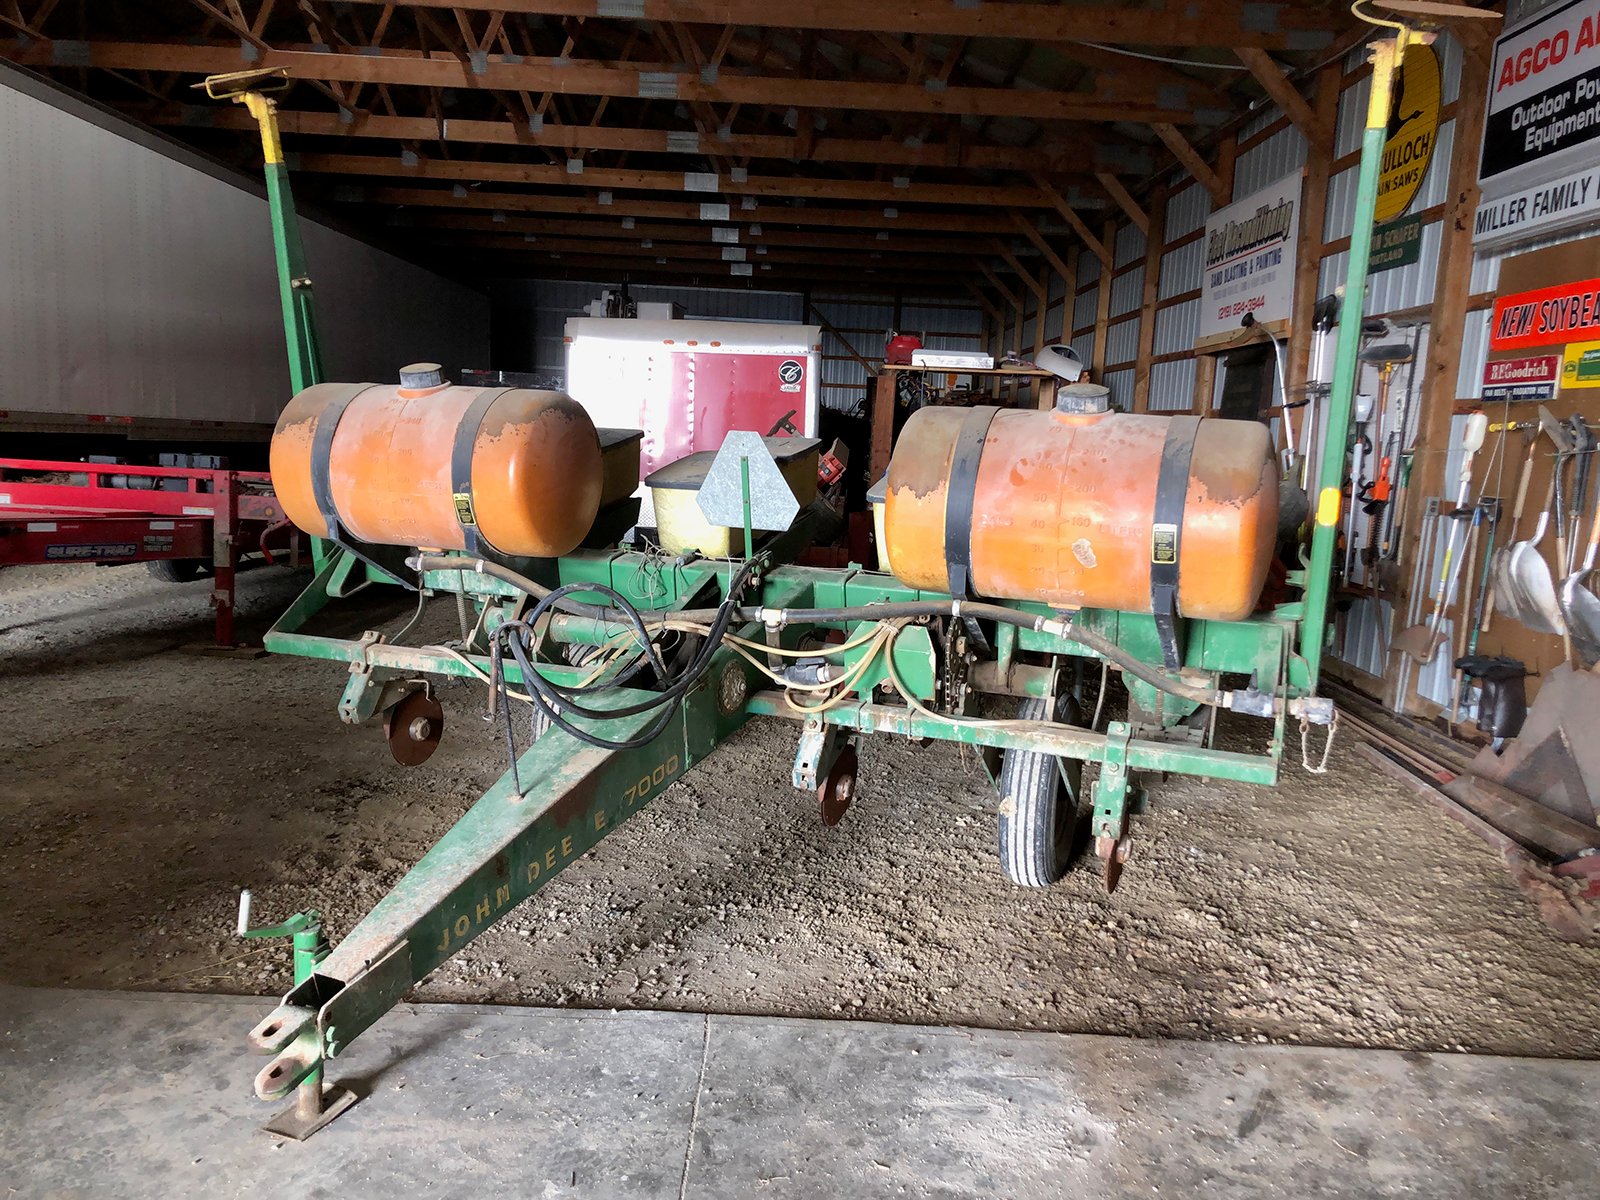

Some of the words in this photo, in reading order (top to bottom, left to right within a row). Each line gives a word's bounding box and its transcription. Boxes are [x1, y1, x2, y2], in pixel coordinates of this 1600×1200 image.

[1497, 29, 1570, 93] AGCO
[1511, 90, 1571, 131] Outdoor
[1524, 101, 1600, 152] Equipment
[1380, 132, 1431, 175] ULLOCH
[1392, 167, 1420, 191] SAWS
[1475, 197, 1528, 235] MILLER
[1531, 175, 1593, 219] FAMILY
[1223, 261, 1248, 284] BLASTING
[1255, 247, 1282, 273] PAINTING
[1496, 301, 1539, 340] NEW!
[46, 544, 137, 559] SURE-TRAC
[437, 883, 511, 952] JOHN
[527, 809, 607, 884] DEEE
[624, 754, 679, 808] 7000
